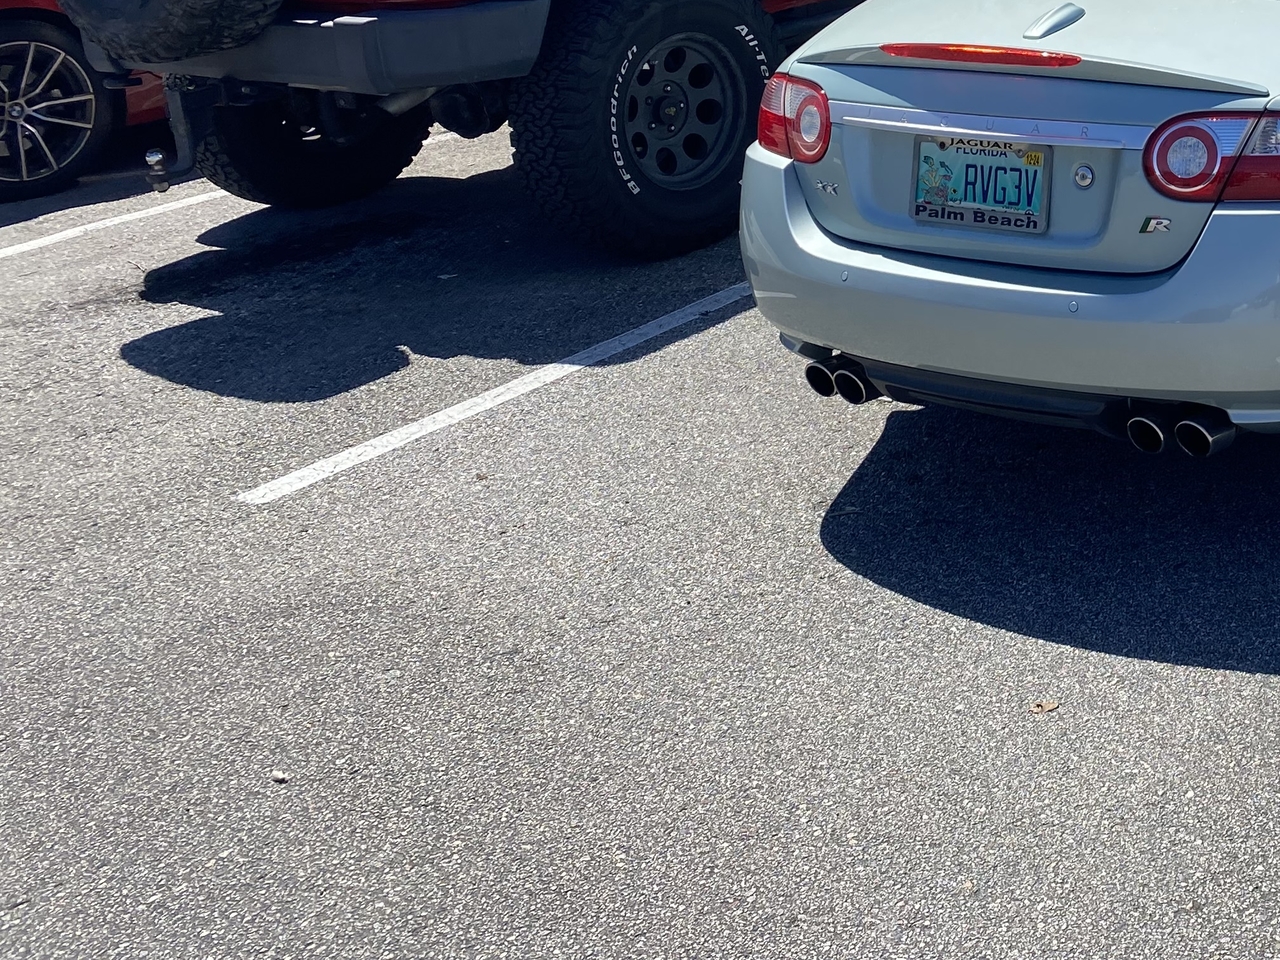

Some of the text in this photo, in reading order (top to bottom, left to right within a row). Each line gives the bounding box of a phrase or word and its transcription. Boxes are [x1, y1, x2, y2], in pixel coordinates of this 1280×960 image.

[609, 44, 641, 195] BFGoodrich
[867, 107, 1089, 137] JAGUAR
[949, 137, 1014, 150] JAGUAR
[955, 146, 1008, 158] FLORIDA
[816, 179, 838, 197] XK
[963, 163, 1038, 208] RVG3V
[914, 204, 1038, 230] Palm Beach
[1142, 217, 1171, 233] R
